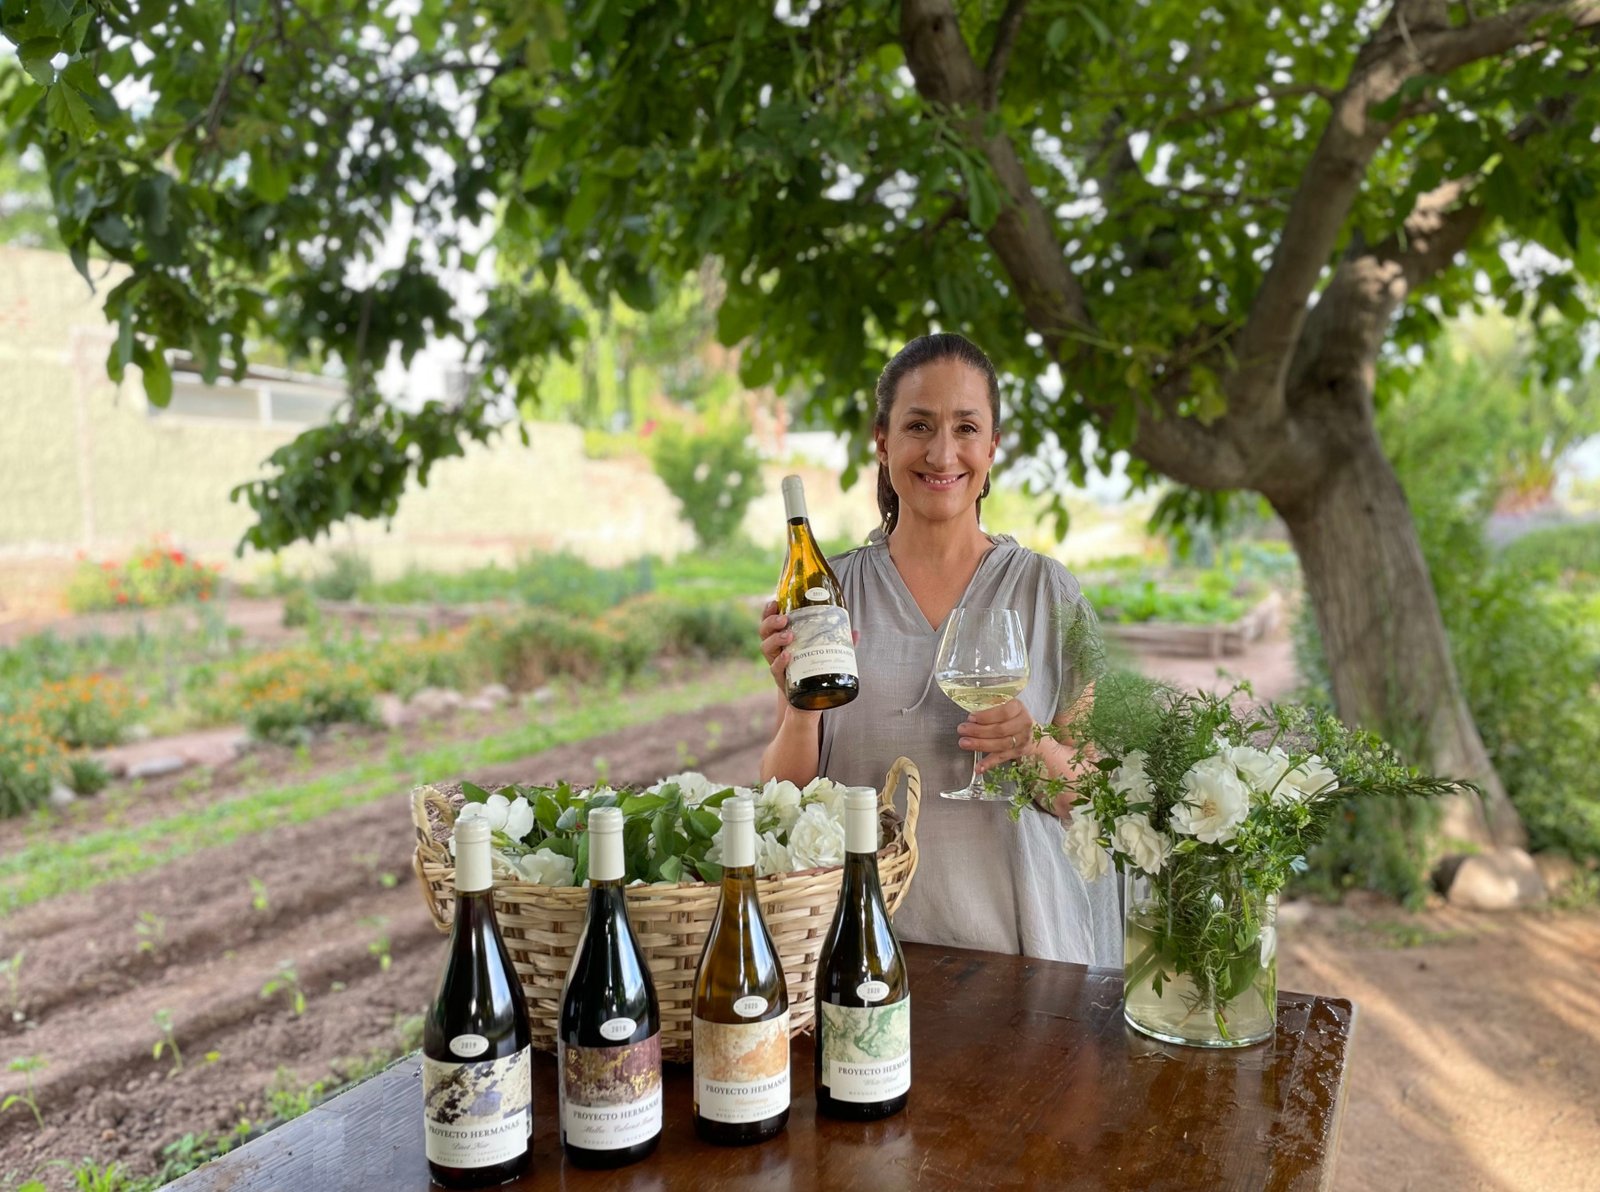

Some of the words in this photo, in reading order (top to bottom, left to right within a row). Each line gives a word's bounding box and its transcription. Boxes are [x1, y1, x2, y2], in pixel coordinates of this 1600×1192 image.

[793, 649, 825, 661] PROYECTO
[838, 1066, 881, 1076] PROYECTO
[705, 1084, 749, 1096] PROYECTO
[573, 1110, 618, 1121] PROYECTO
[428, 1124, 468, 1139] PROYECTO
[470, 1119, 520, 1139] HERMANAS
